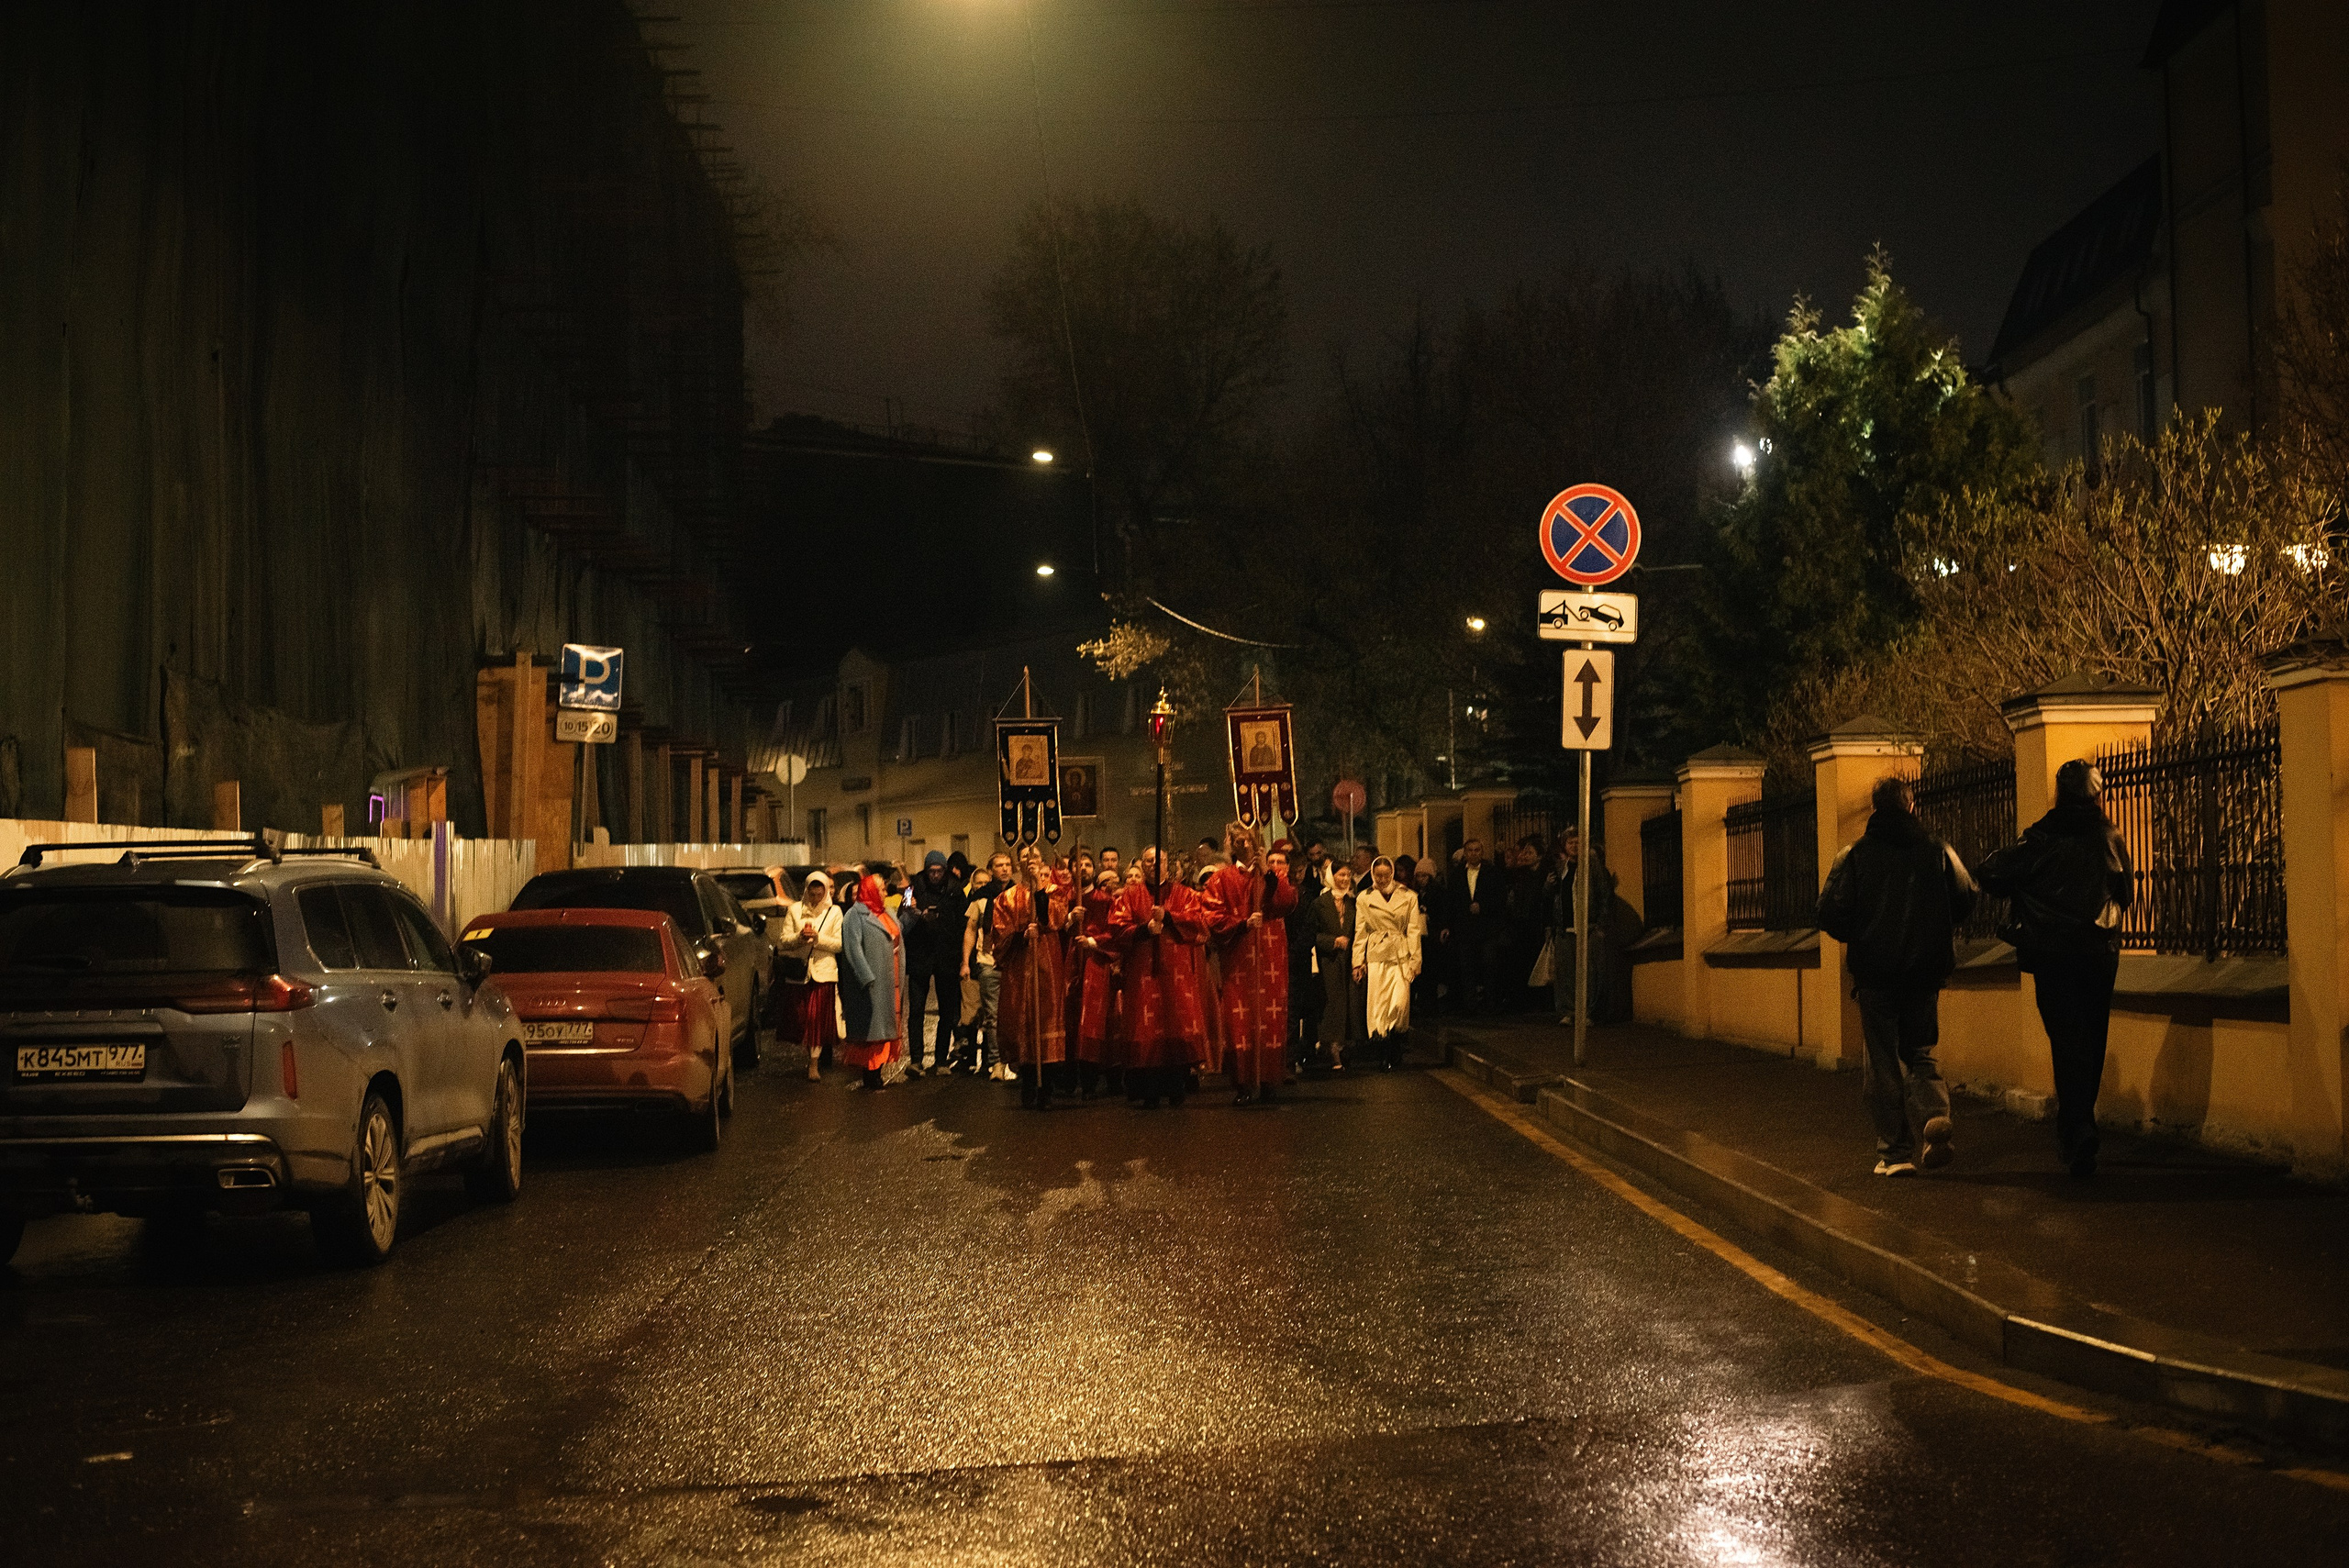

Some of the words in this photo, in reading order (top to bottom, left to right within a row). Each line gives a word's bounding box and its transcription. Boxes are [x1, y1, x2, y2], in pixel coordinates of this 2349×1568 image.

[578, 651, 610, 699] P
[522, 1024, 564, 1039] 95ОУ
[568, 1022, 588, 1034] 777
[24, 1046, 104, 1068] К845МТ
[108, 1044, 140, 1061] 977
